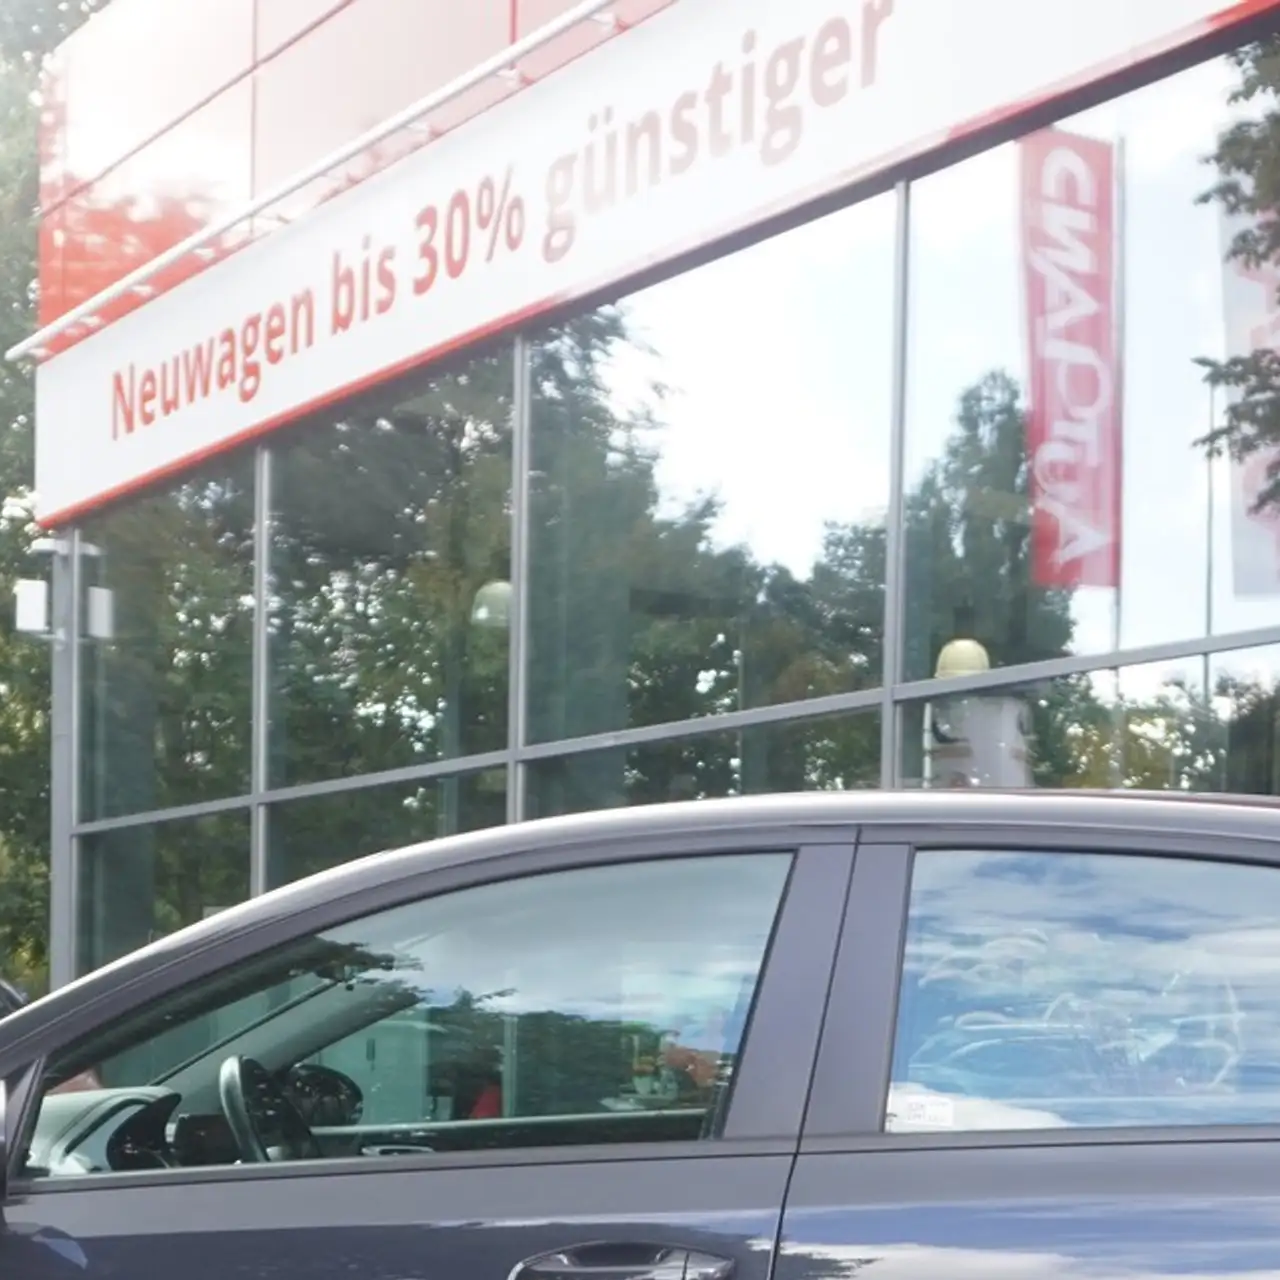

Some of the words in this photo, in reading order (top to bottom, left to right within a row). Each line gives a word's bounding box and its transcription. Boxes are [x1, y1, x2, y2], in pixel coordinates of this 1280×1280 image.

[112, 287, 314, 441] Neuwagen
[332, 233, 397, 336] bis
[413, 163, 525, 296] 30%
[542, 0, 894, 263] günstiger
